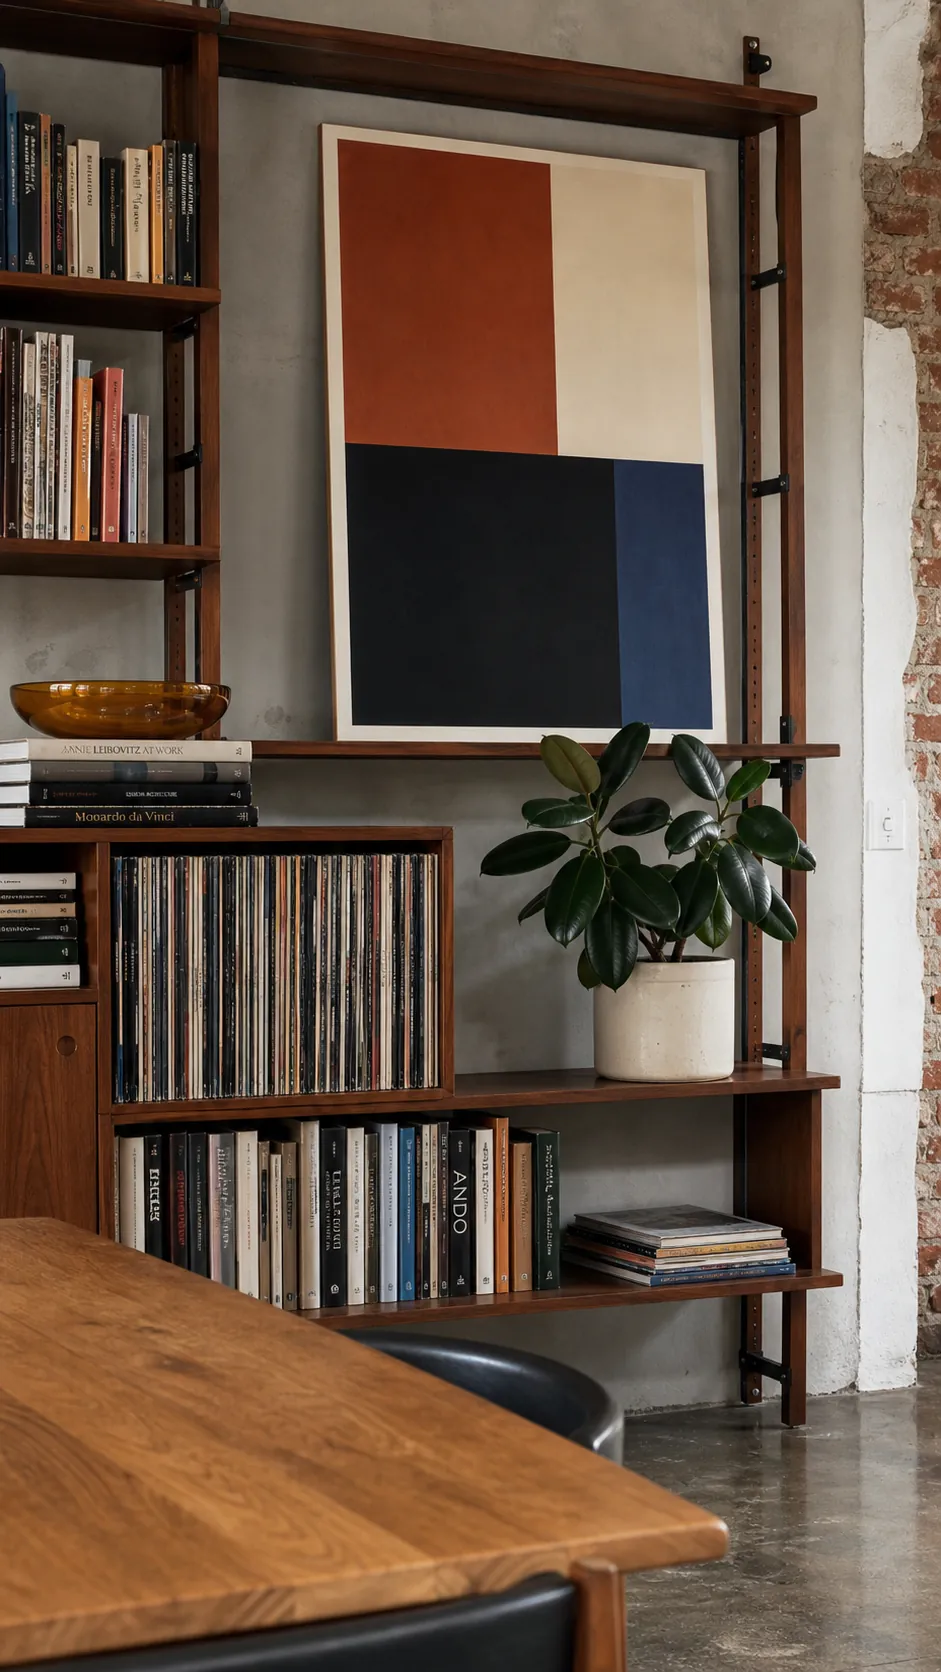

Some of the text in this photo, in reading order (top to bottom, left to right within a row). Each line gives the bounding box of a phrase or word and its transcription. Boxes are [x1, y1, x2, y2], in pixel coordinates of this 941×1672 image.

[93, 745, 141, 755] LEIBOVITZ
[143, 746, 155, 755] AT
[154, 746, 184, 755] WORK
[144, 811, 175, 822] Vinci
[452, 1169, 469, 1235] ANDO
